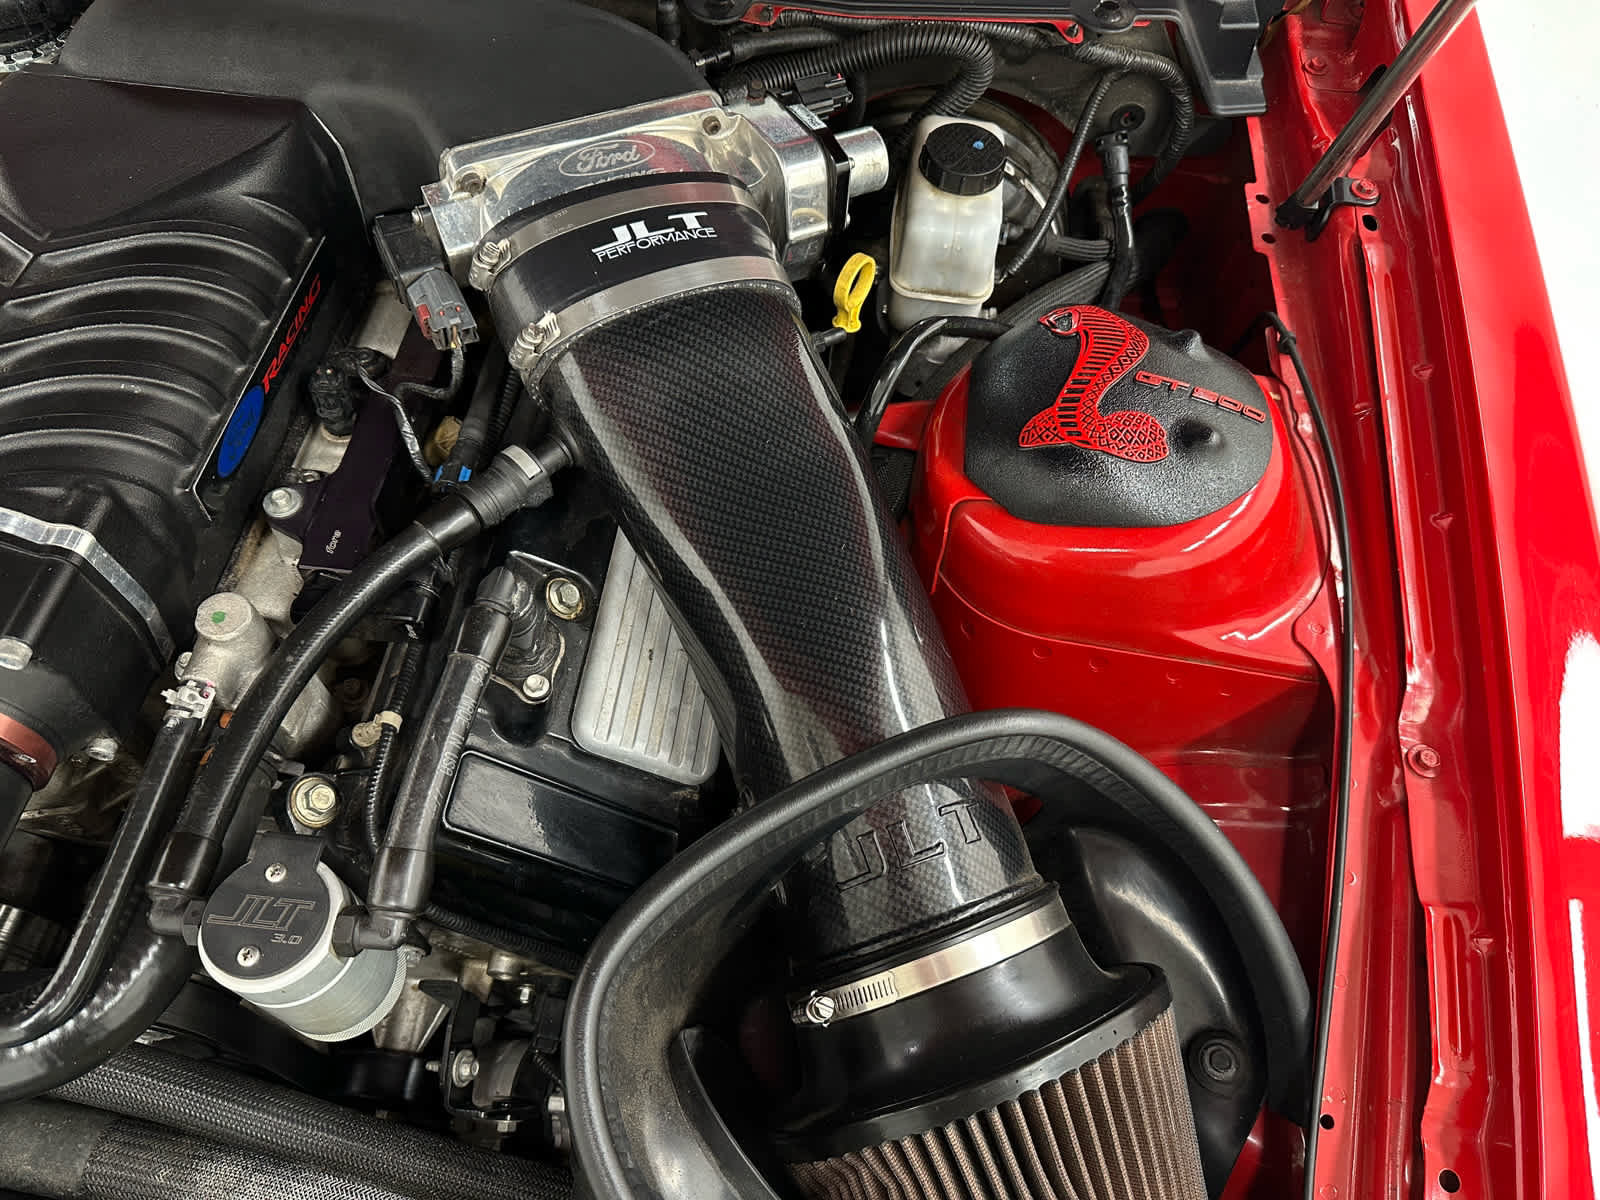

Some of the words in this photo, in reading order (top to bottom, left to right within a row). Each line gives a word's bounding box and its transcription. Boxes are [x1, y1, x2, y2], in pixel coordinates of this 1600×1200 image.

[576, 143, 641, 172] Ford
[592, 211, 708, 253] JLT
[595, 227, 718, 263] PERFORMANCE
[262, 273, 321, 394] RACING
[456, 694, 477, 729] MADE
[447, 729, 464, 748] IN
[440, 751, 459, 776] USA
[835, 800, 981, 893] JLT
[206, 894, 316, 932] JLT
[271, 932, 302, 945] 3.0
